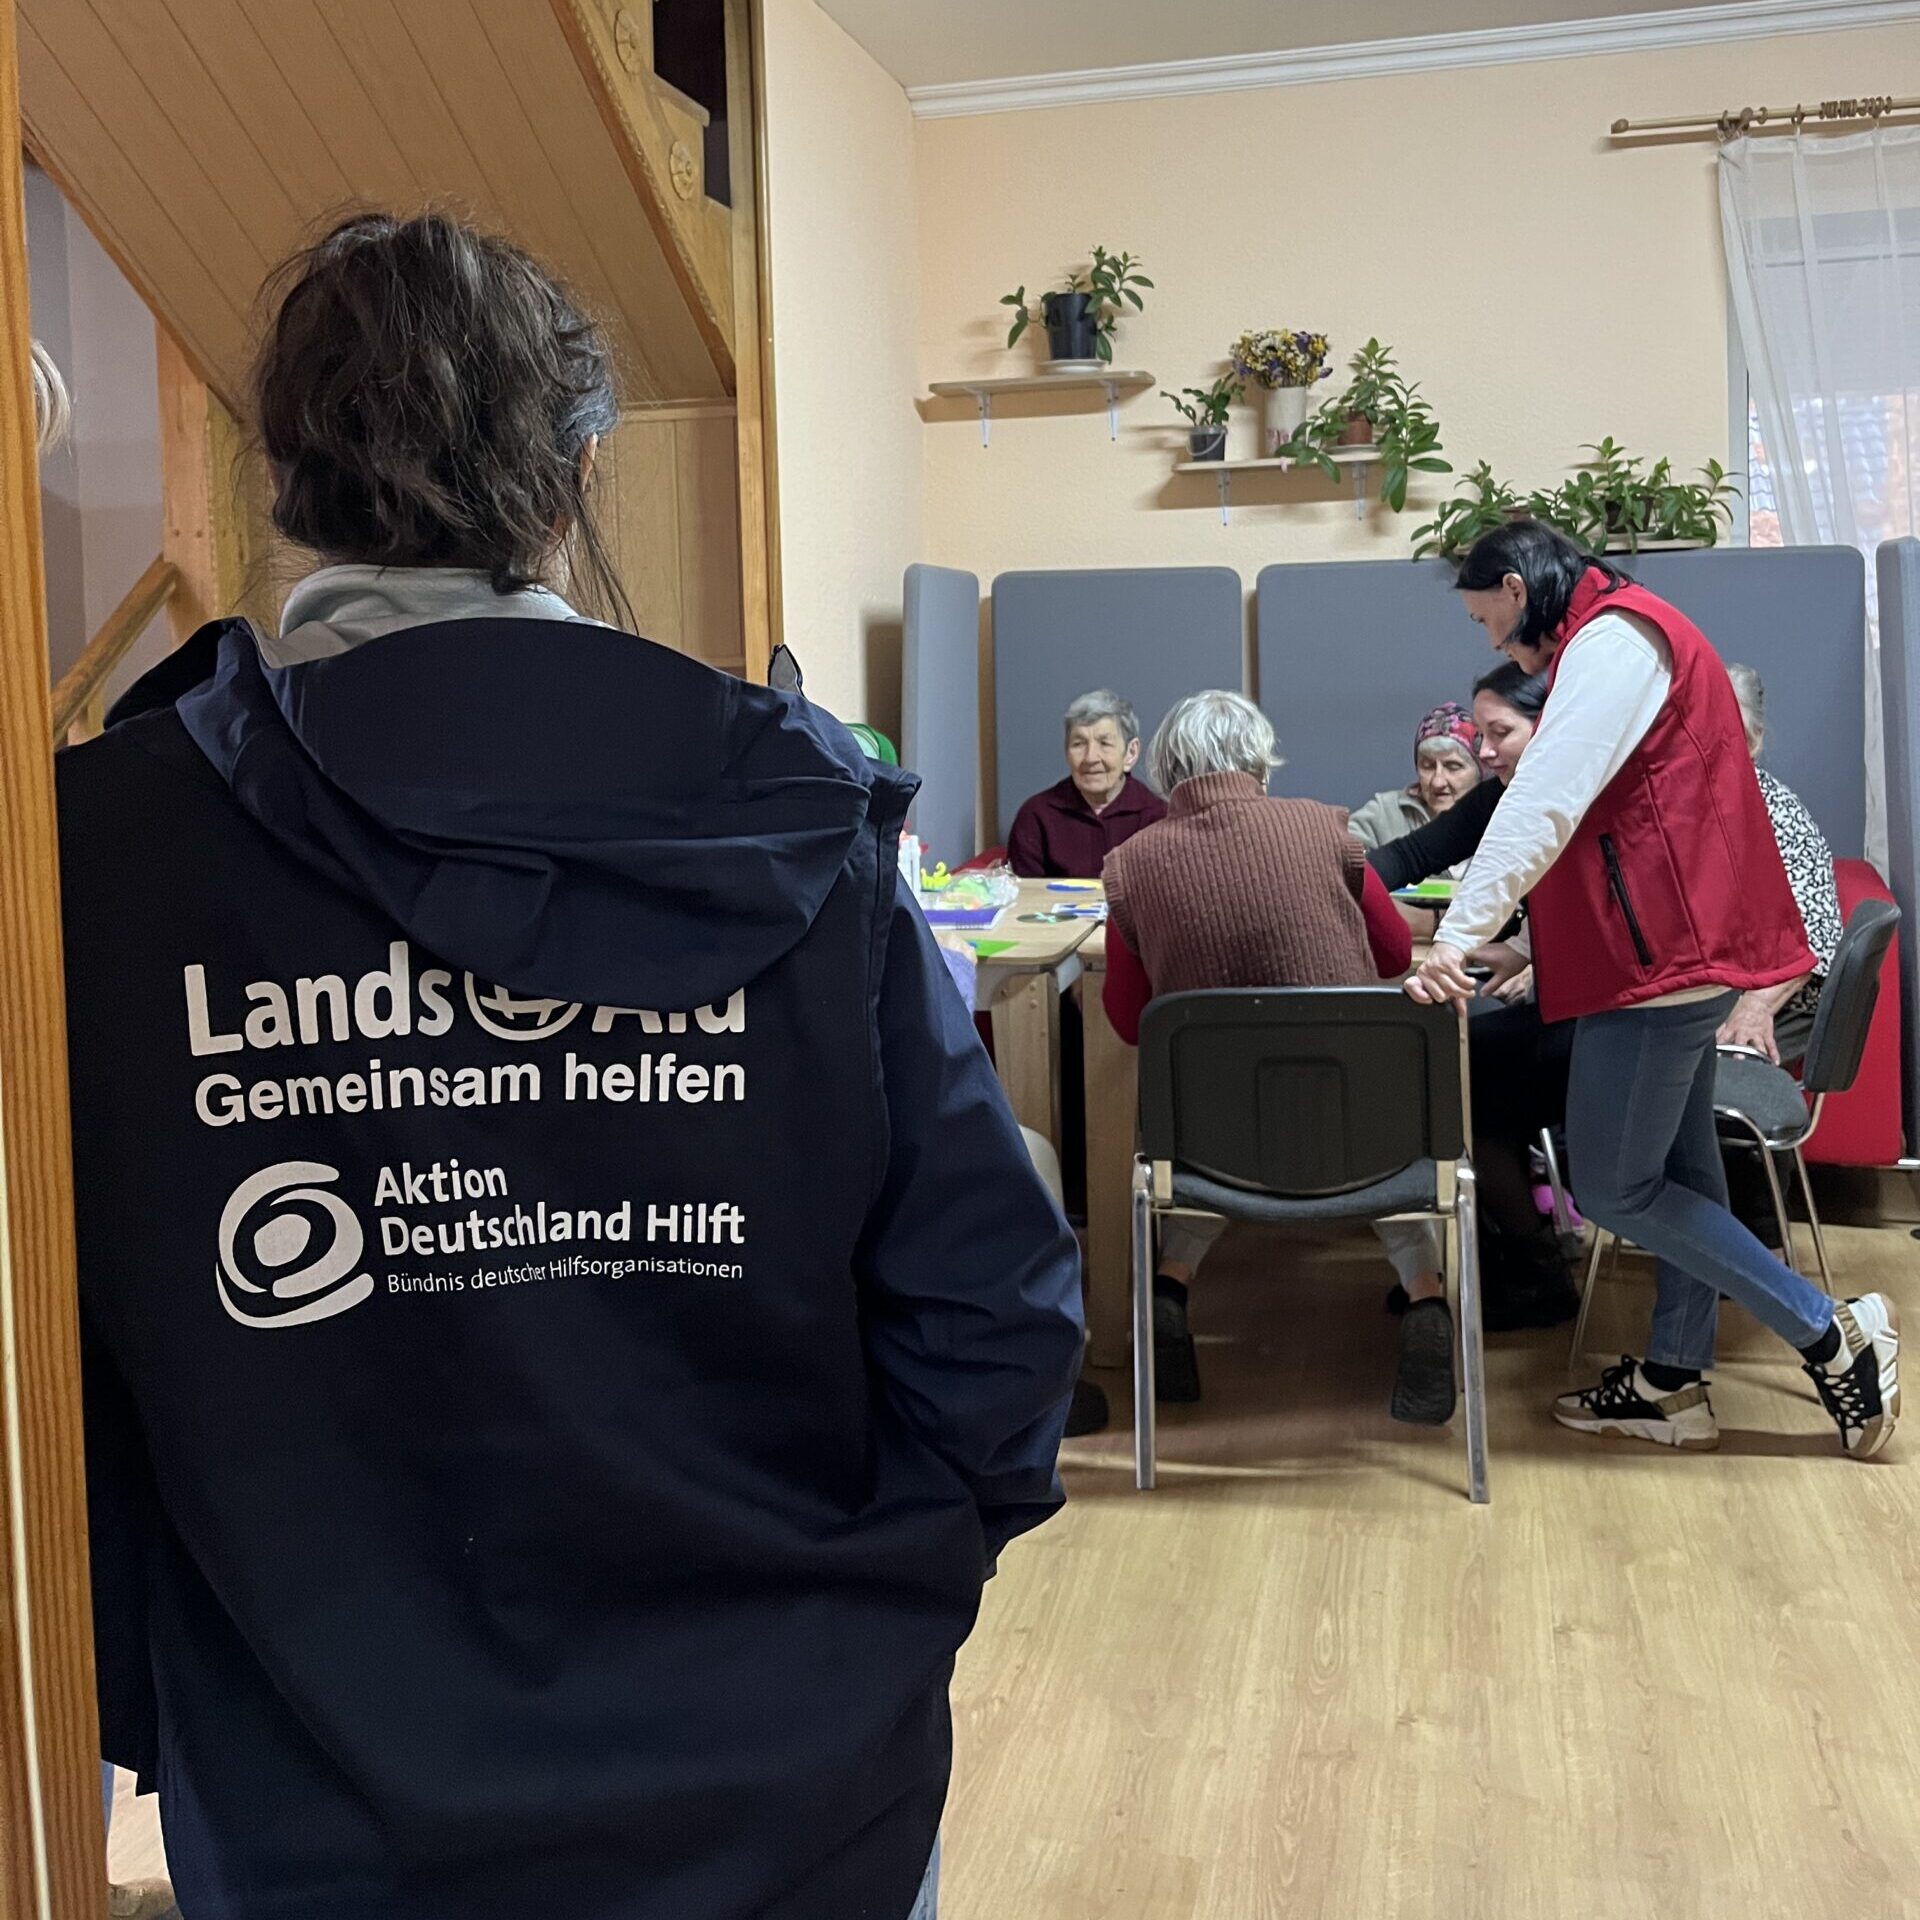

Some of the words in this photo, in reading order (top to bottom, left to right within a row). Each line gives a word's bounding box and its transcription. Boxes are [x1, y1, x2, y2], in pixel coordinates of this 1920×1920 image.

[184, 941, 455, 1057] Lands
[195, 1058, 541, 1127] Gemeinsam
[565, 1052, 745, 1104] helfen
[374, 1158, 508, 1207] Aktion
[380, 1200, 631, 1256] Deutschland
[647, 1202, 746, 1244] Hilft
[387, 1272, 465, 1293] Bündnis
[470, 1262, 546, 1290] deutscher
[549, 1255, 743, 1280] Hilfsorganisationen
